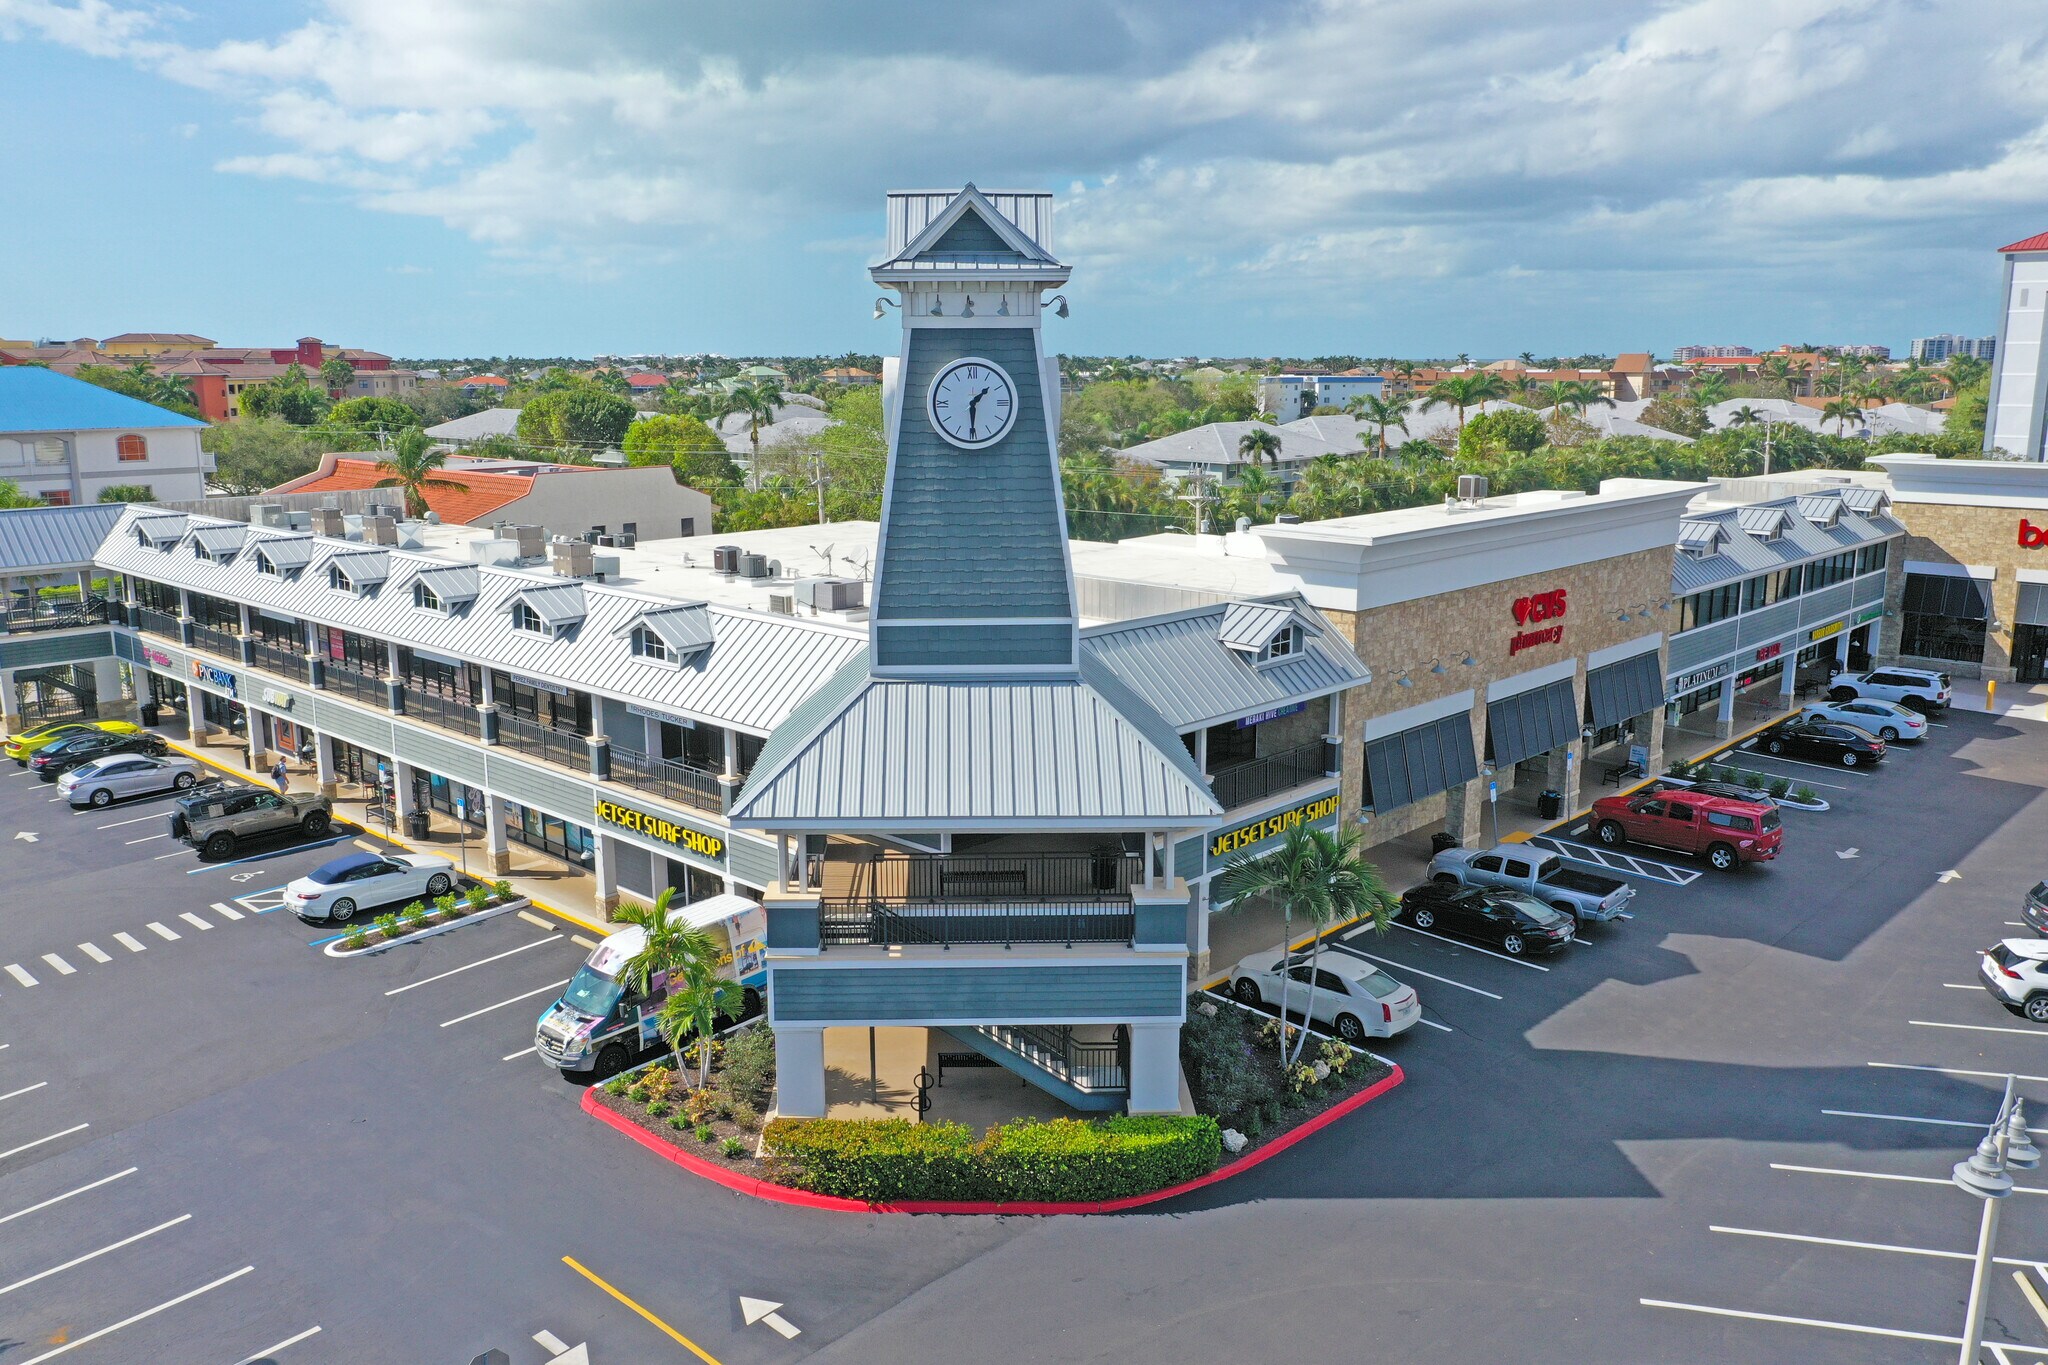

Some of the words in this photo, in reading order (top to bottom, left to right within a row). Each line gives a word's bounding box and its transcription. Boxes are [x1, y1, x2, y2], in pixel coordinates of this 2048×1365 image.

[967, 367, 978, 379] XII
[1530, 588, 1567, 623] CVS
[1683, 666, 1719, 689] PLATINUM
[633, 705, 660, 718] RHODES
[661, 713, 688, 725] TUCKER
[594, 800, 642, 831] JETSET
[643, 816, 681, 843] SURF
[682, 829, 721, 857] SHOP
[1212, 820, 1267, 856] JETSET
[1268, 808, 1305, 837] SURF
[1306, 795, 1341, 824] SHOP
